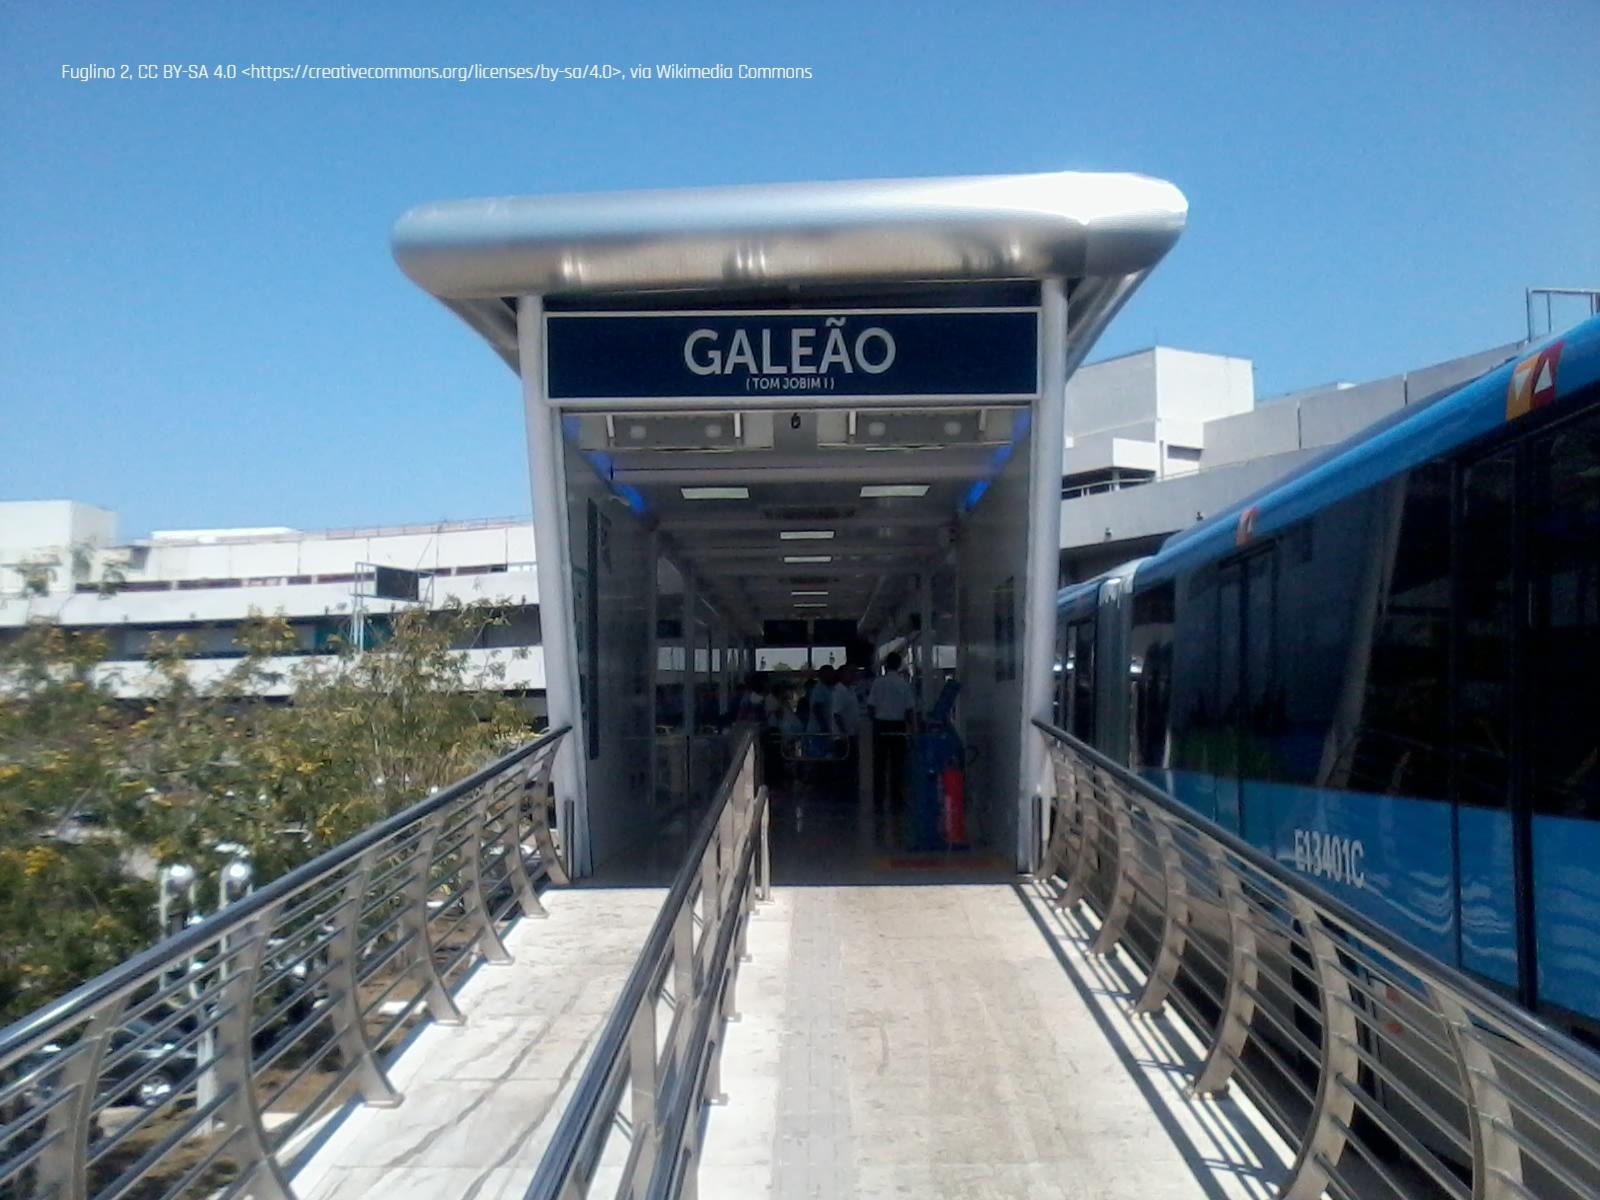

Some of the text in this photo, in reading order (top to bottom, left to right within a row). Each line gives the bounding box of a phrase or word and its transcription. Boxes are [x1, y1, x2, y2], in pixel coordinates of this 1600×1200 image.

[683, 316, 897, 376] GALEÃO
[782, 377, 821, 390] JOBIM
[1294, 828, 1365, 889] E13401C
